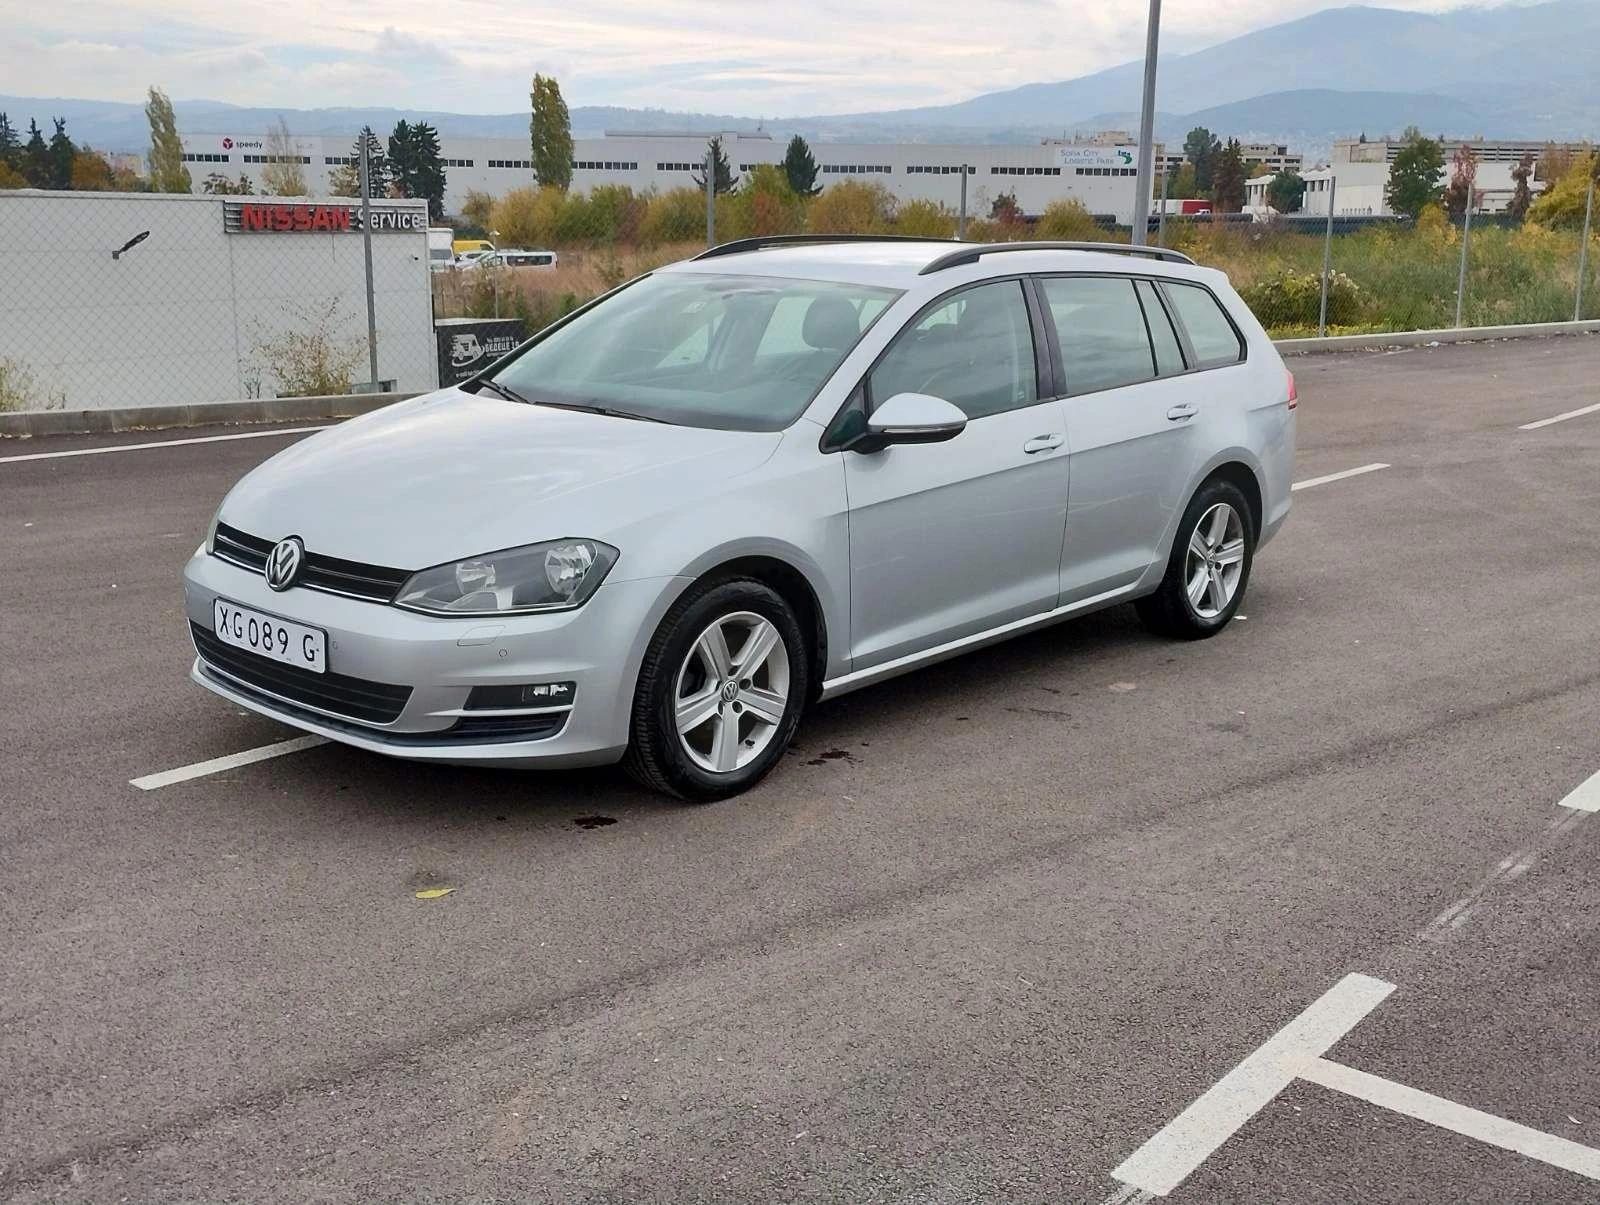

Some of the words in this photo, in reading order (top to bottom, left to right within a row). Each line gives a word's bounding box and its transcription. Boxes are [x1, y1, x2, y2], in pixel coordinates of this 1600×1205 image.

[236, 141, 263, 149] speedy
[241, 204, 351, 232] NISSAN
[220, 606, 289, 655] XG089
[303, 634, 315, 662] G
